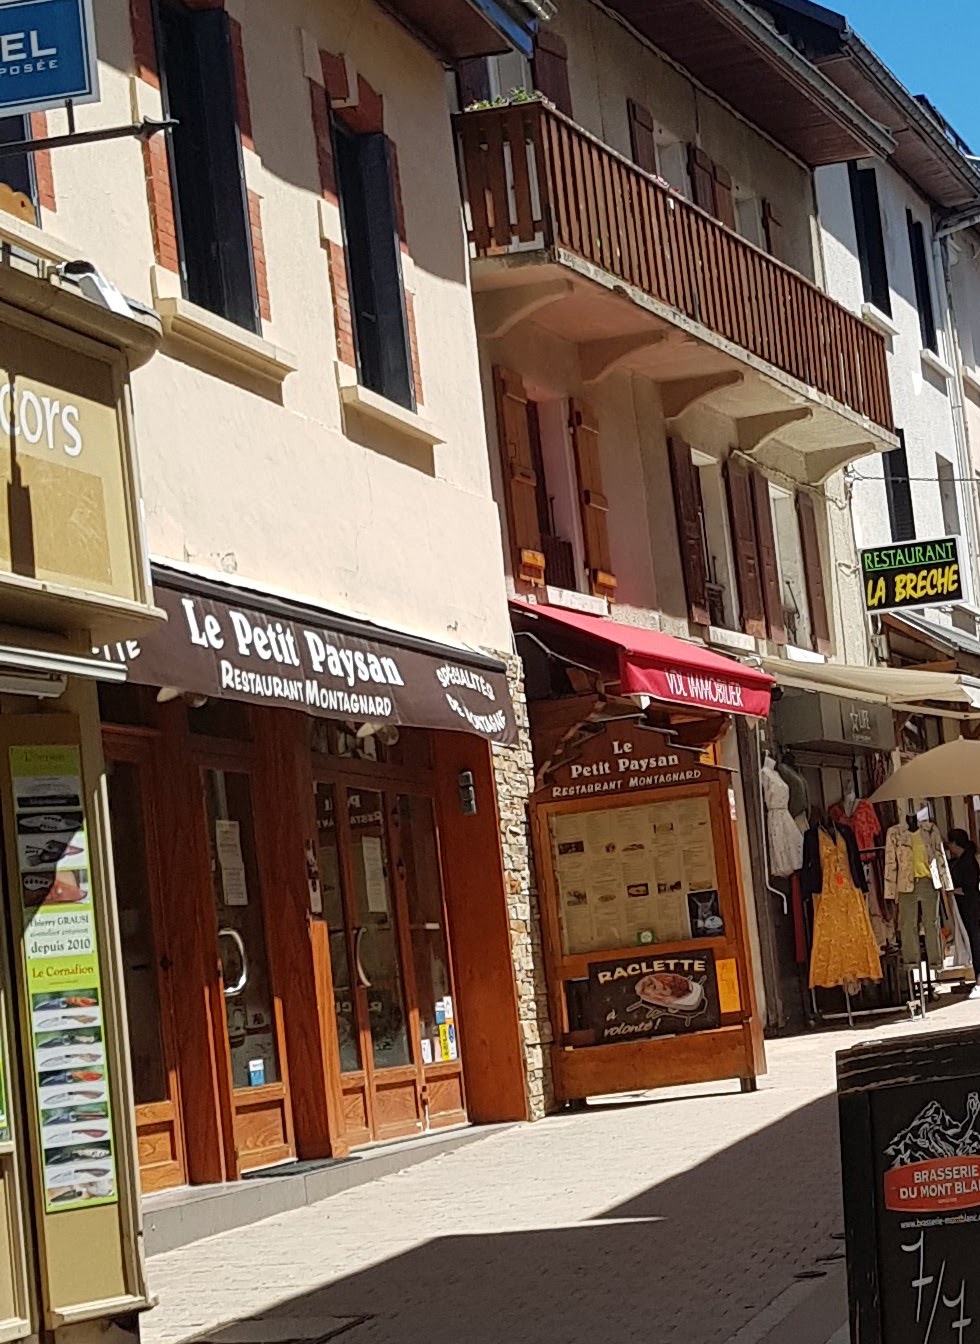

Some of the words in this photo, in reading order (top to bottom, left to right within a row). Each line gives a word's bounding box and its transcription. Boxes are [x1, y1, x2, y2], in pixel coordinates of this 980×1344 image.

[864, 542, 954, 569] RESTAURANT
[867, 576, 886, 606] LA
[894, 564, 958, 603] BRECHE
[182, 597, 224, 650] Le
[229, 609, 300, 667] Petit
[304, 630, 404, 688] Paysan
[221, 660, 303, 703] RESTAURANT
[304, 680, 392, 717] MONTAGNARD
[612, 740, 633, 755] Le
[570, 761, 611, 779] Petit
[618, 753, 679, 773] Paysan
[629, 768, 702, 788] MONTAGNARD
[31, 941, 64, 954] depuis
[67, 938, 91, 951] 2010
[32, 968, 44, 978] Le
[597, 959, 706, 984] RACLETTE
[914, 1165, 980, 1184] BRASSERIE
[900, 1187, 918, 1200] DU
[920, 1183, 952, 1198] MONT
